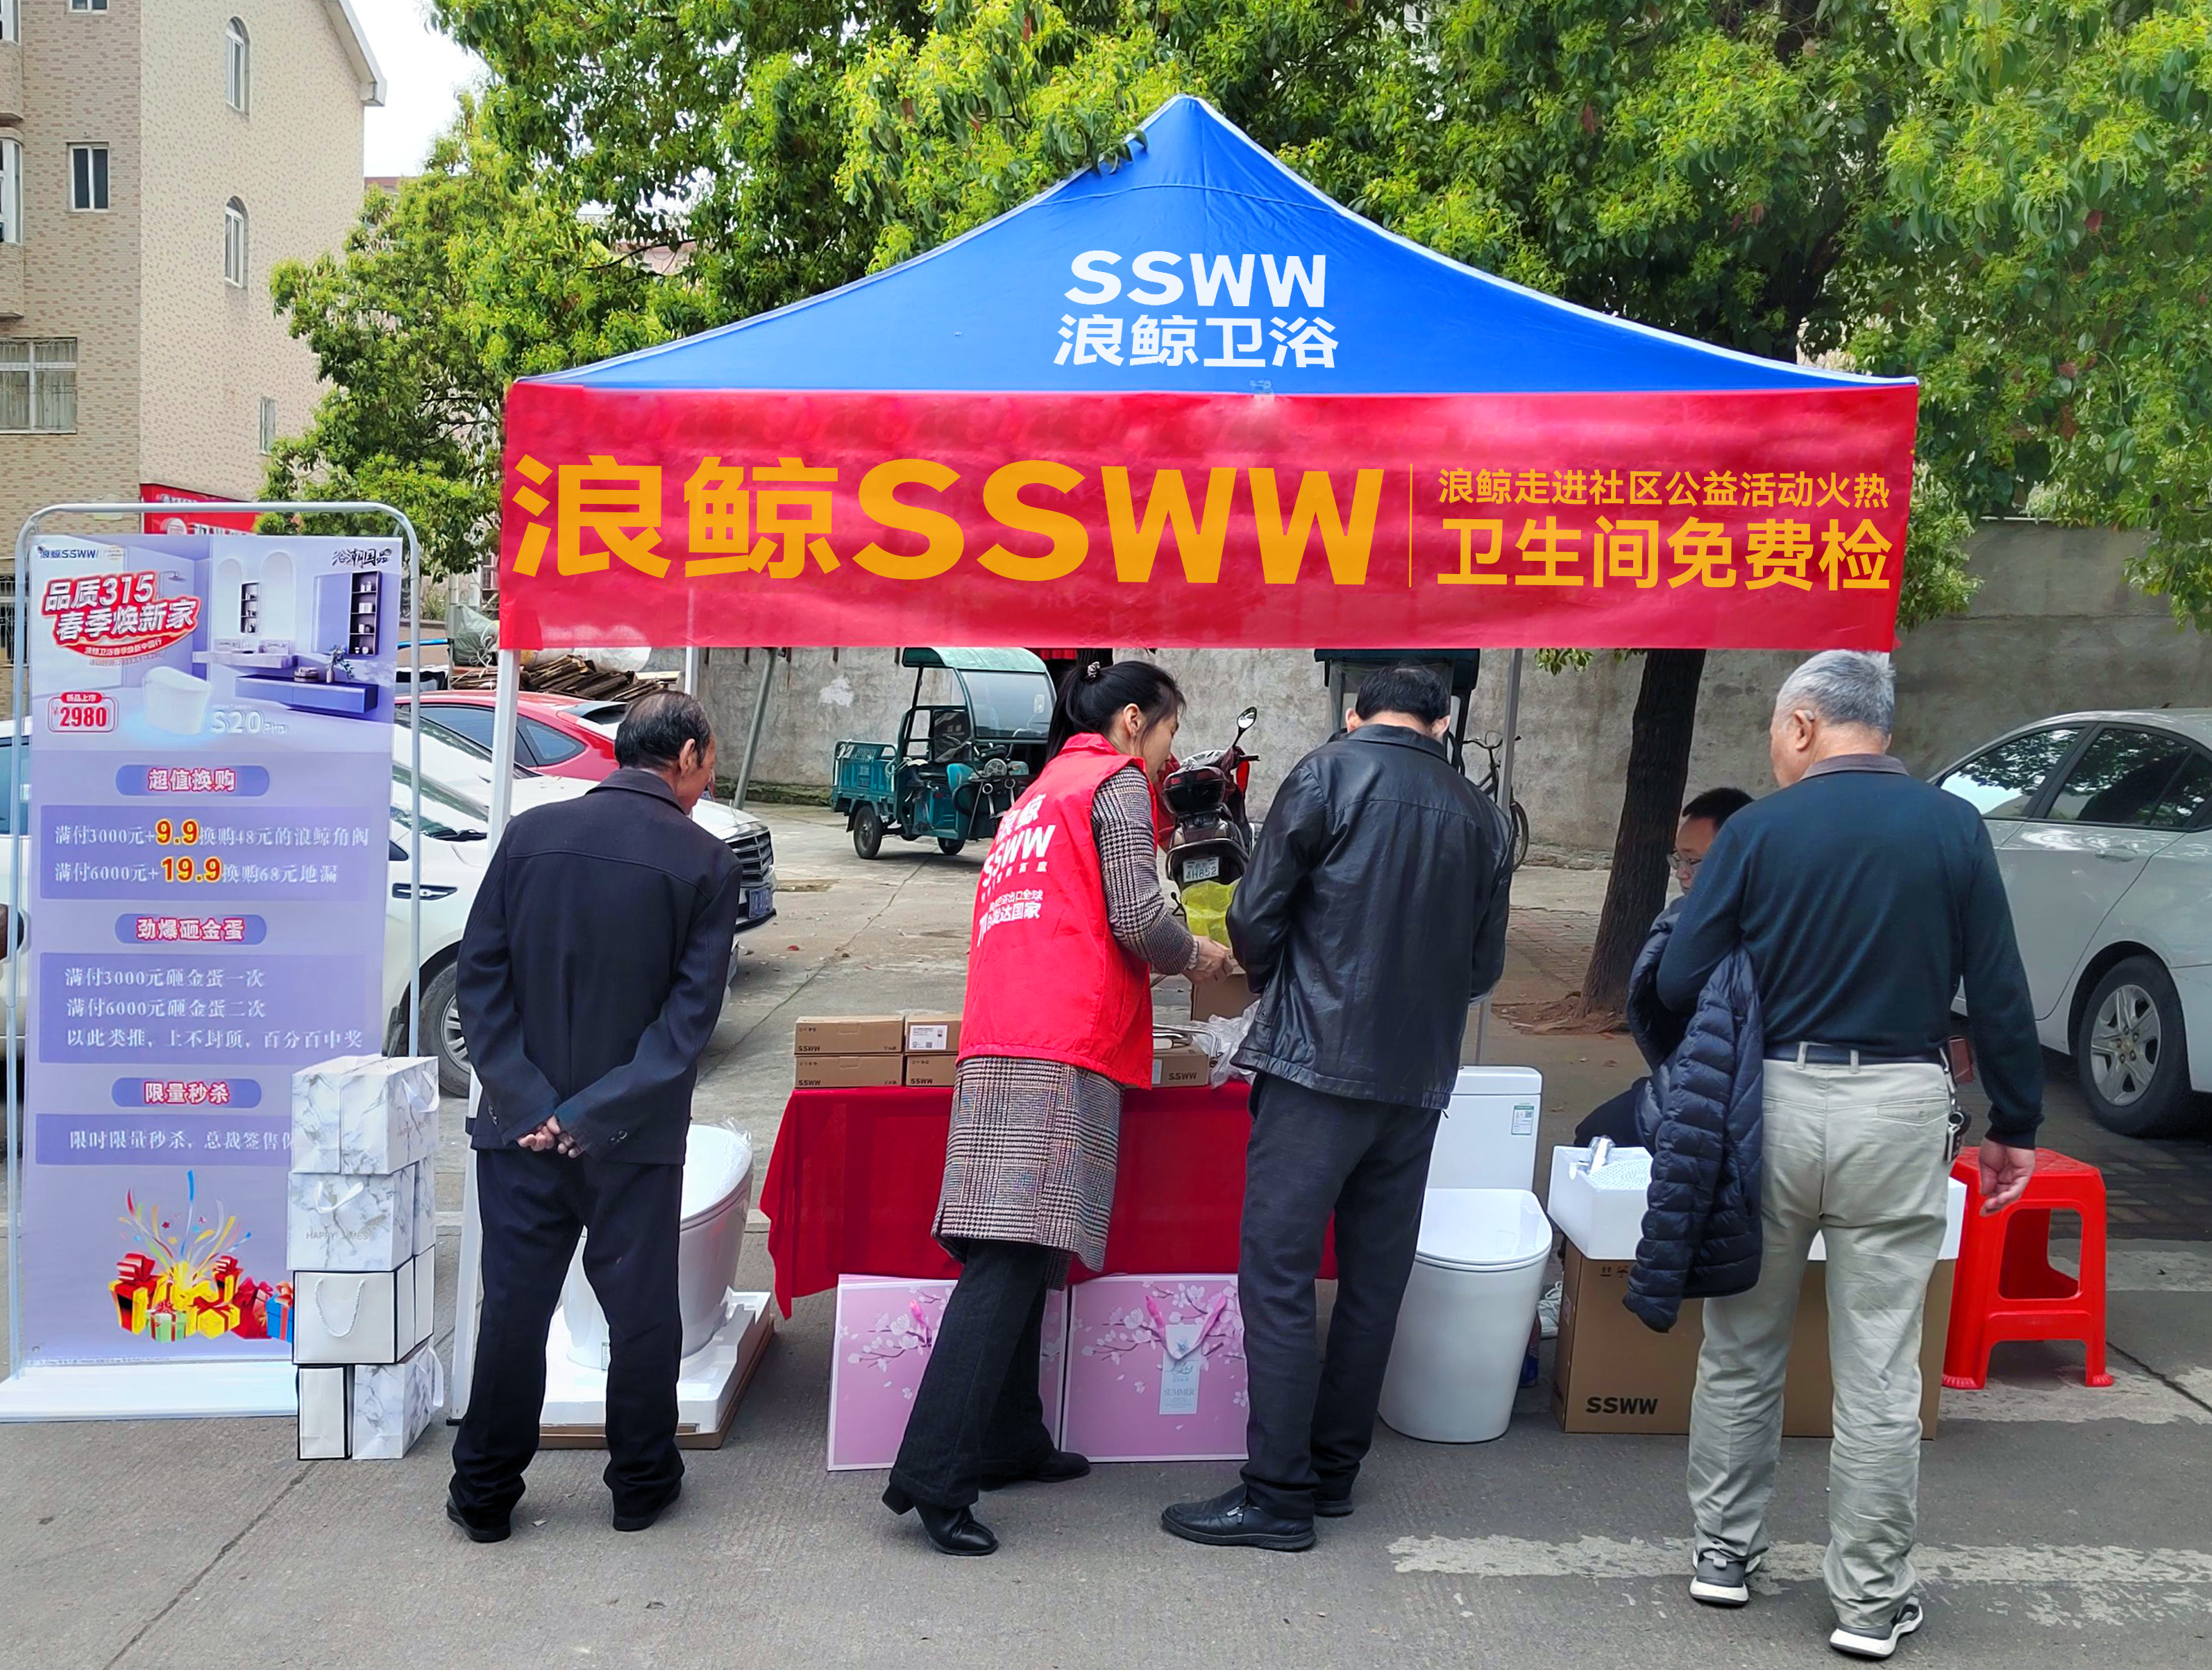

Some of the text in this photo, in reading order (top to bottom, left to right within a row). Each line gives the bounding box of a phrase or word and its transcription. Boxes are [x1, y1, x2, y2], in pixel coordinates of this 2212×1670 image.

[1064, 250, 1326, 307] SSWW
[1053, 314, 1339, 368] 浪鲸卫浴
[1438, 468, 1891, 509] 浪鲸走进社区公益活动火热
[511, 453, 1385, 585] 浪鲸SSWW
[1437, 516, 1893, 591] 卫生间免费检
[44, 574, 153, 612] 品质315
[57, 599, 196, 641] 春季焕新家
[148, 768, 237, 791] 超值换购
[981, 825, 1056, 888] SSWW
[137, 918, 245, 941] 劲爆砸金蛋
[65, 968, 266, 987] 满付3000元砸金蛋一次
[67, 998, 267, 1018] 满付6000元砸金蛋二次
[143, 1082, 231, 1104] 限量秒杀
[1586, 1397, 1658, 1415] SSWW
